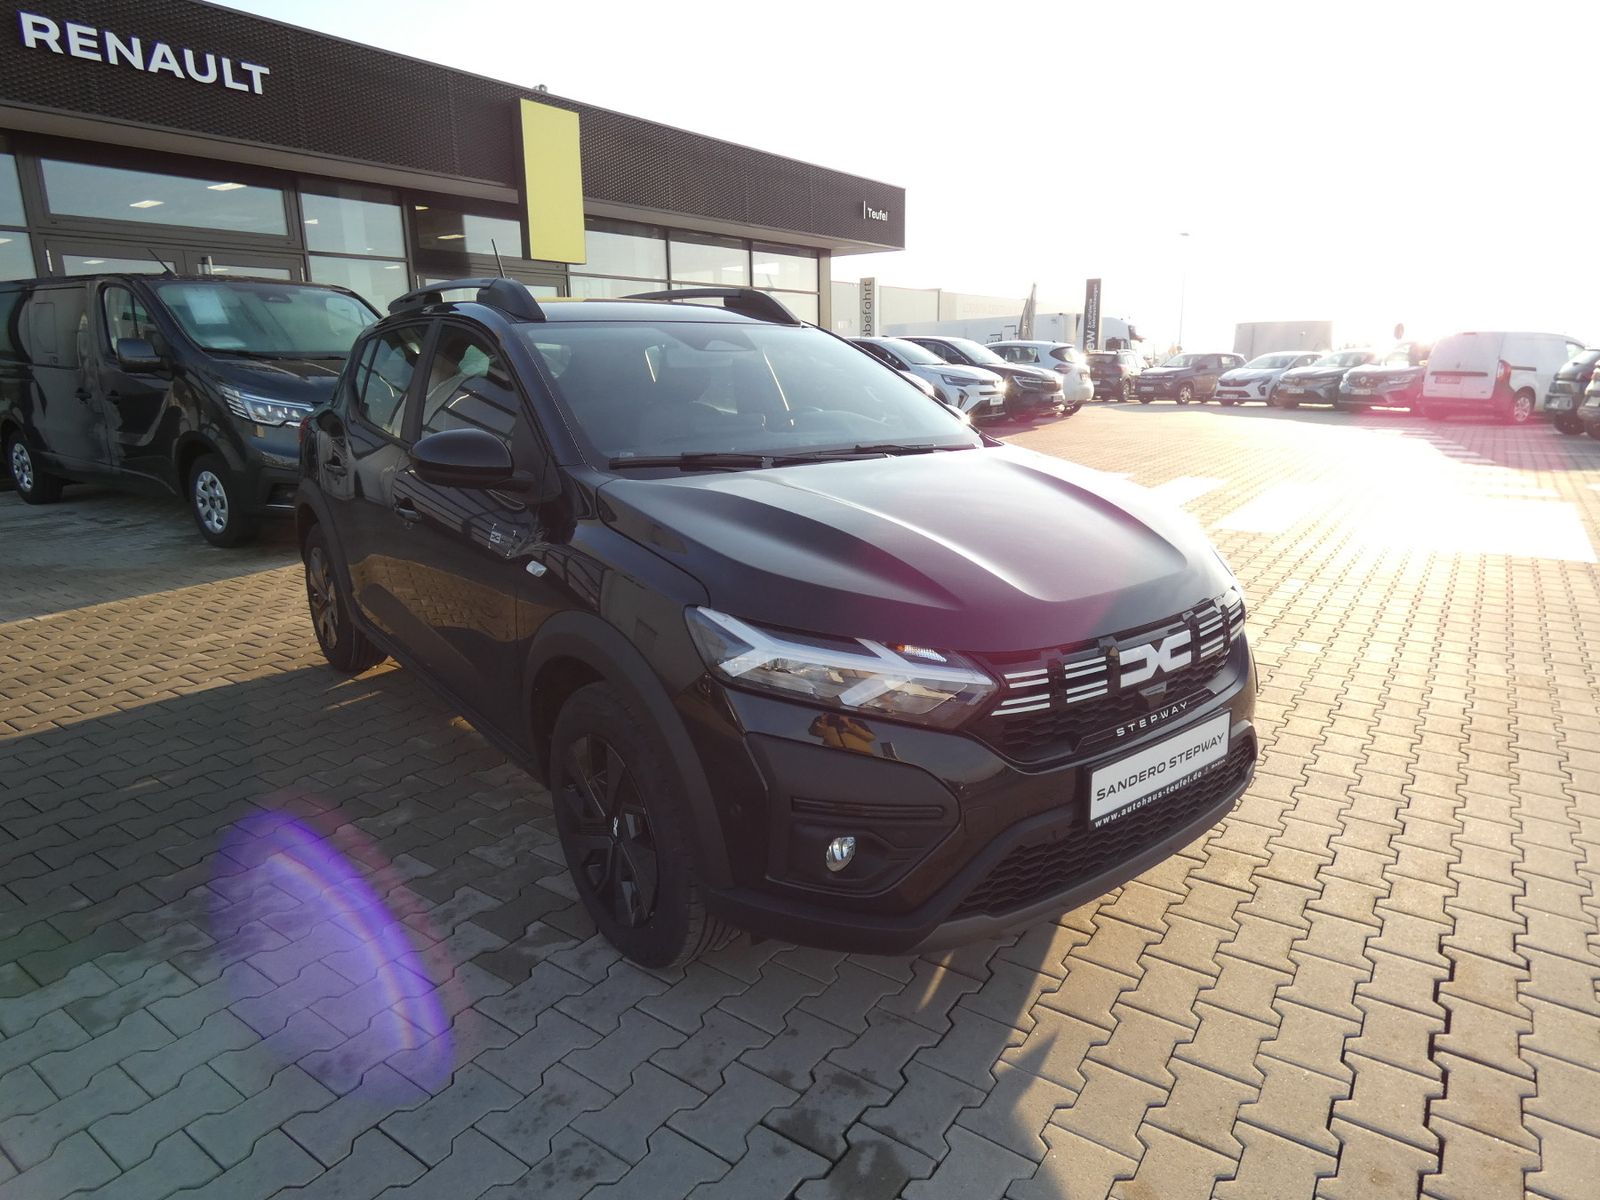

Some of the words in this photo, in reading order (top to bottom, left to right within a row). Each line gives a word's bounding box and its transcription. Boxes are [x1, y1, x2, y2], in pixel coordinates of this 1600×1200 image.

[19, 11, 271, 95] RENAULT
[867, 207, 888, 221] Teufel
[1116, 701, 1187, 737] STEPWAY
[1096, 761, 1166, 802] SANDERO
[1168, 732, 1225, 769] STEPWAY
[1094, 770, 1202, 828] www.autohaus-teufel.de
